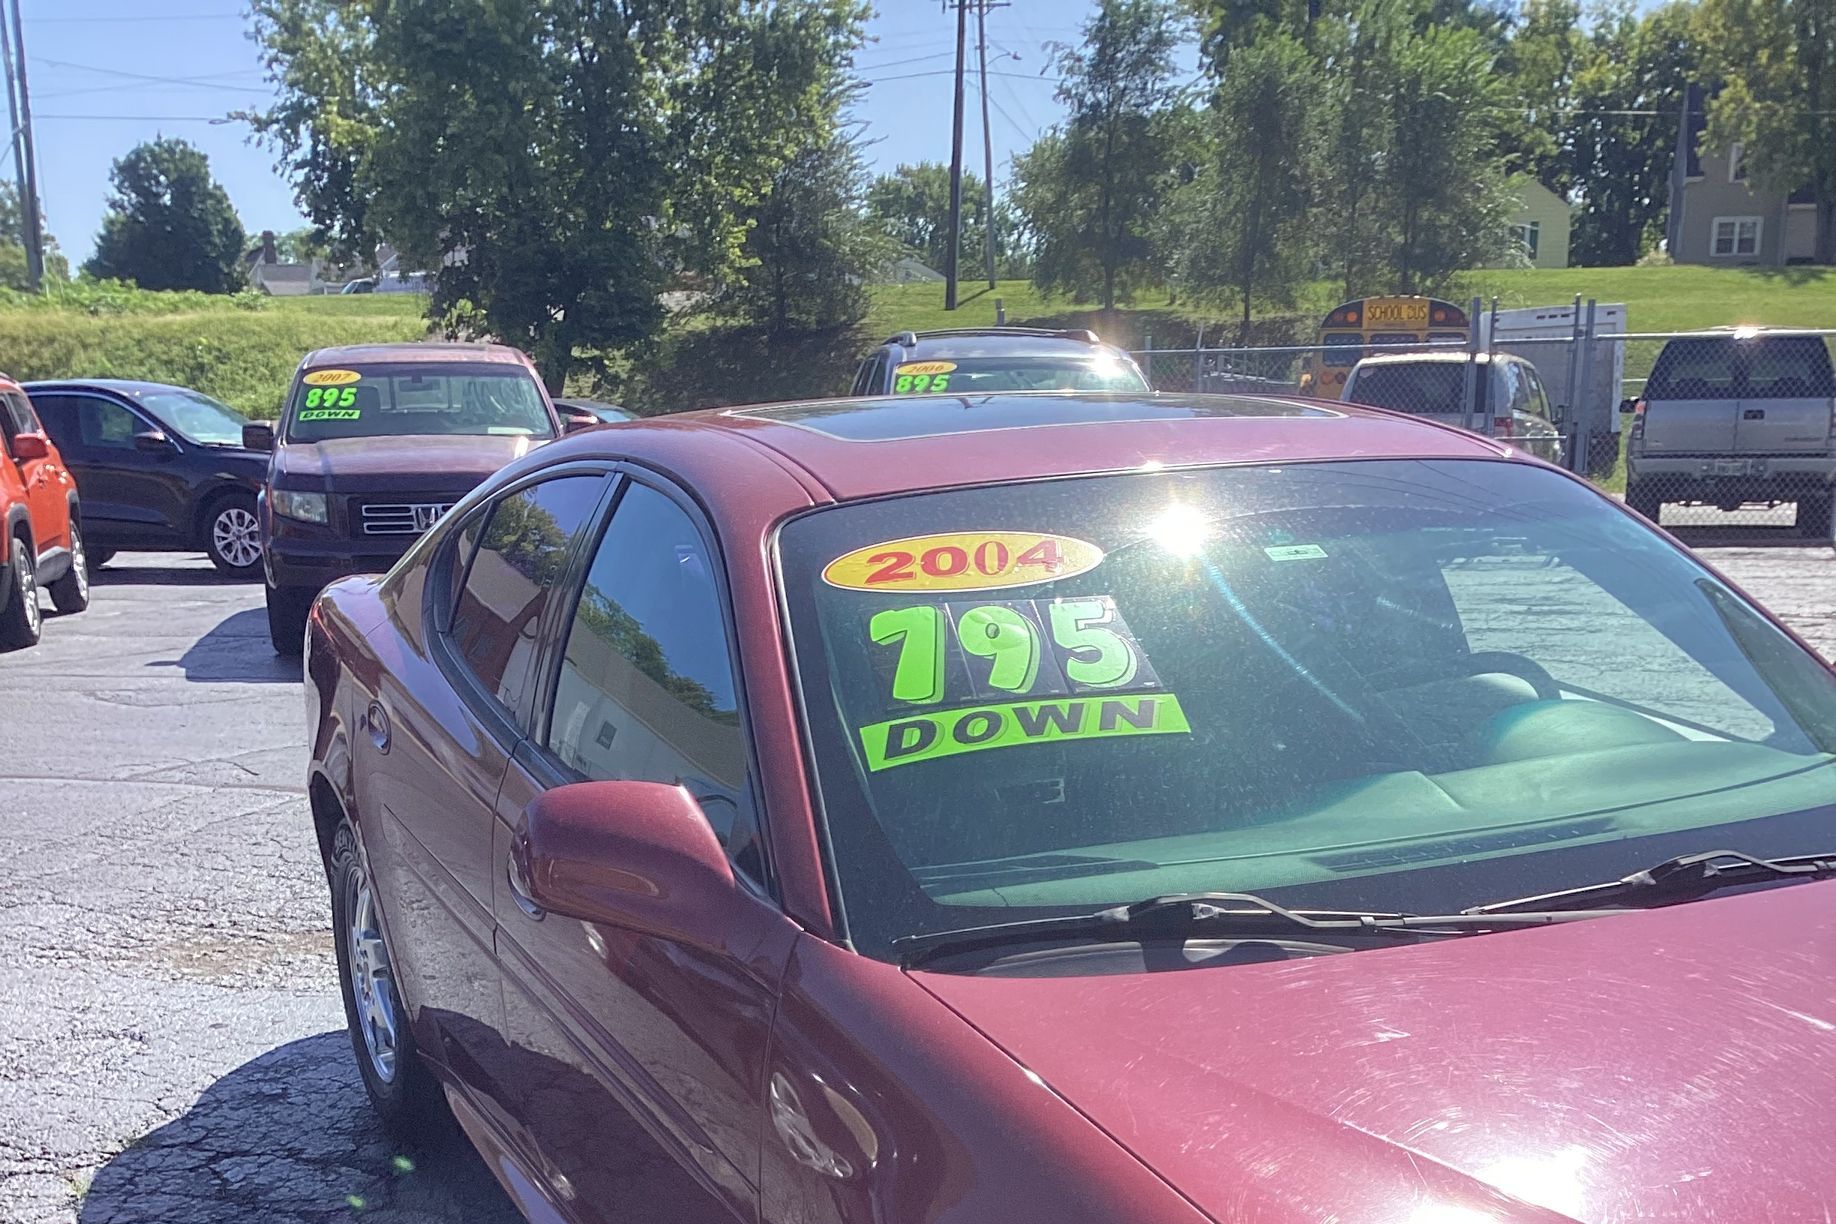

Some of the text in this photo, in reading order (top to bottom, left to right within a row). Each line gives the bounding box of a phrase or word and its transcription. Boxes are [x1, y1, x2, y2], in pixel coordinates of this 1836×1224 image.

[1367, 304, 1427, 321] SCHOOL BUS
[312, 373, 353, 384] 2007
[895, 374, 951, 394] 895
[305, 387, 358, 409] 895
[302, 410, 356, 419] DOWN
[863, 539, 1065, 586] 2004
[869, 600, 1139, 705] 795
[883, 699, 1161, 761] DOWN
